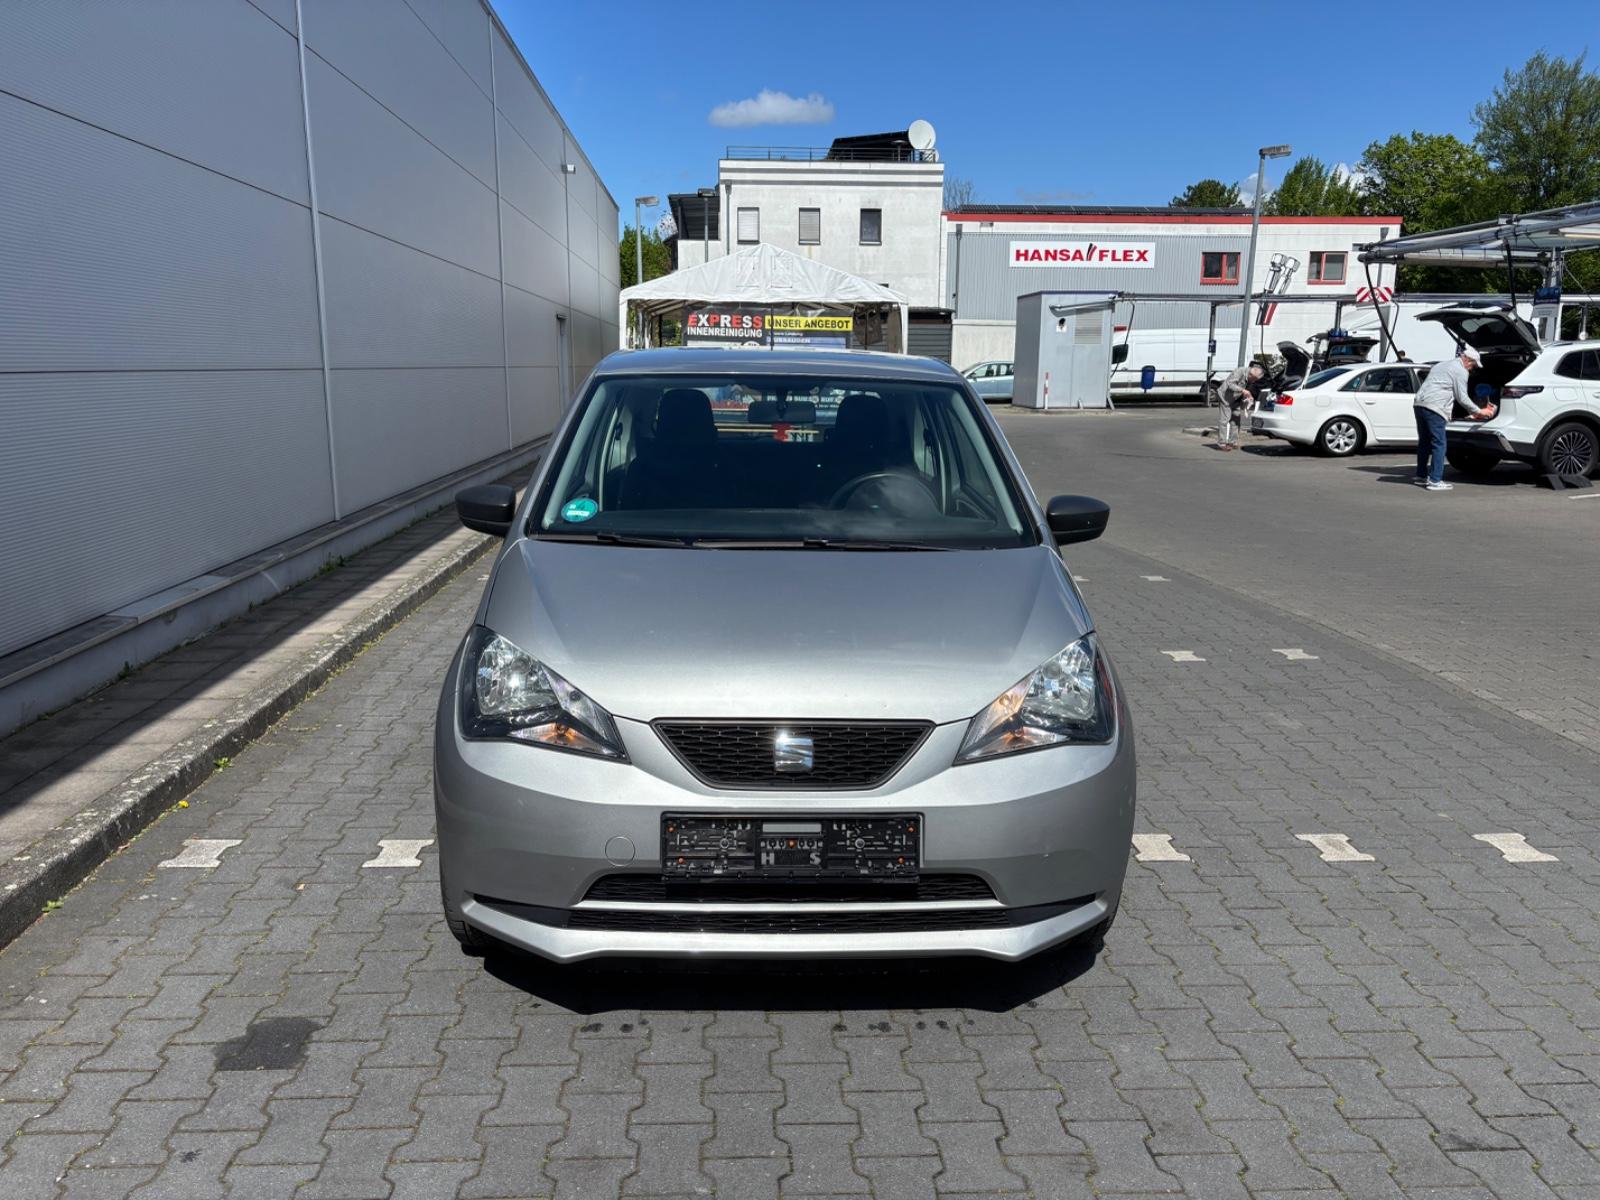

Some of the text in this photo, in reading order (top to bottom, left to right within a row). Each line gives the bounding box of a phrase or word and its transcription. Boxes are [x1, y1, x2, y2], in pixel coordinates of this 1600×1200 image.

[1015, 249, 1149, 262] HANSA FLEX
[688, 313, 763, 328] EXPRESS
[804, 318, 850, 329] ANGEBOT
[687, 326, 763, 338] INNENREINIGUNG
